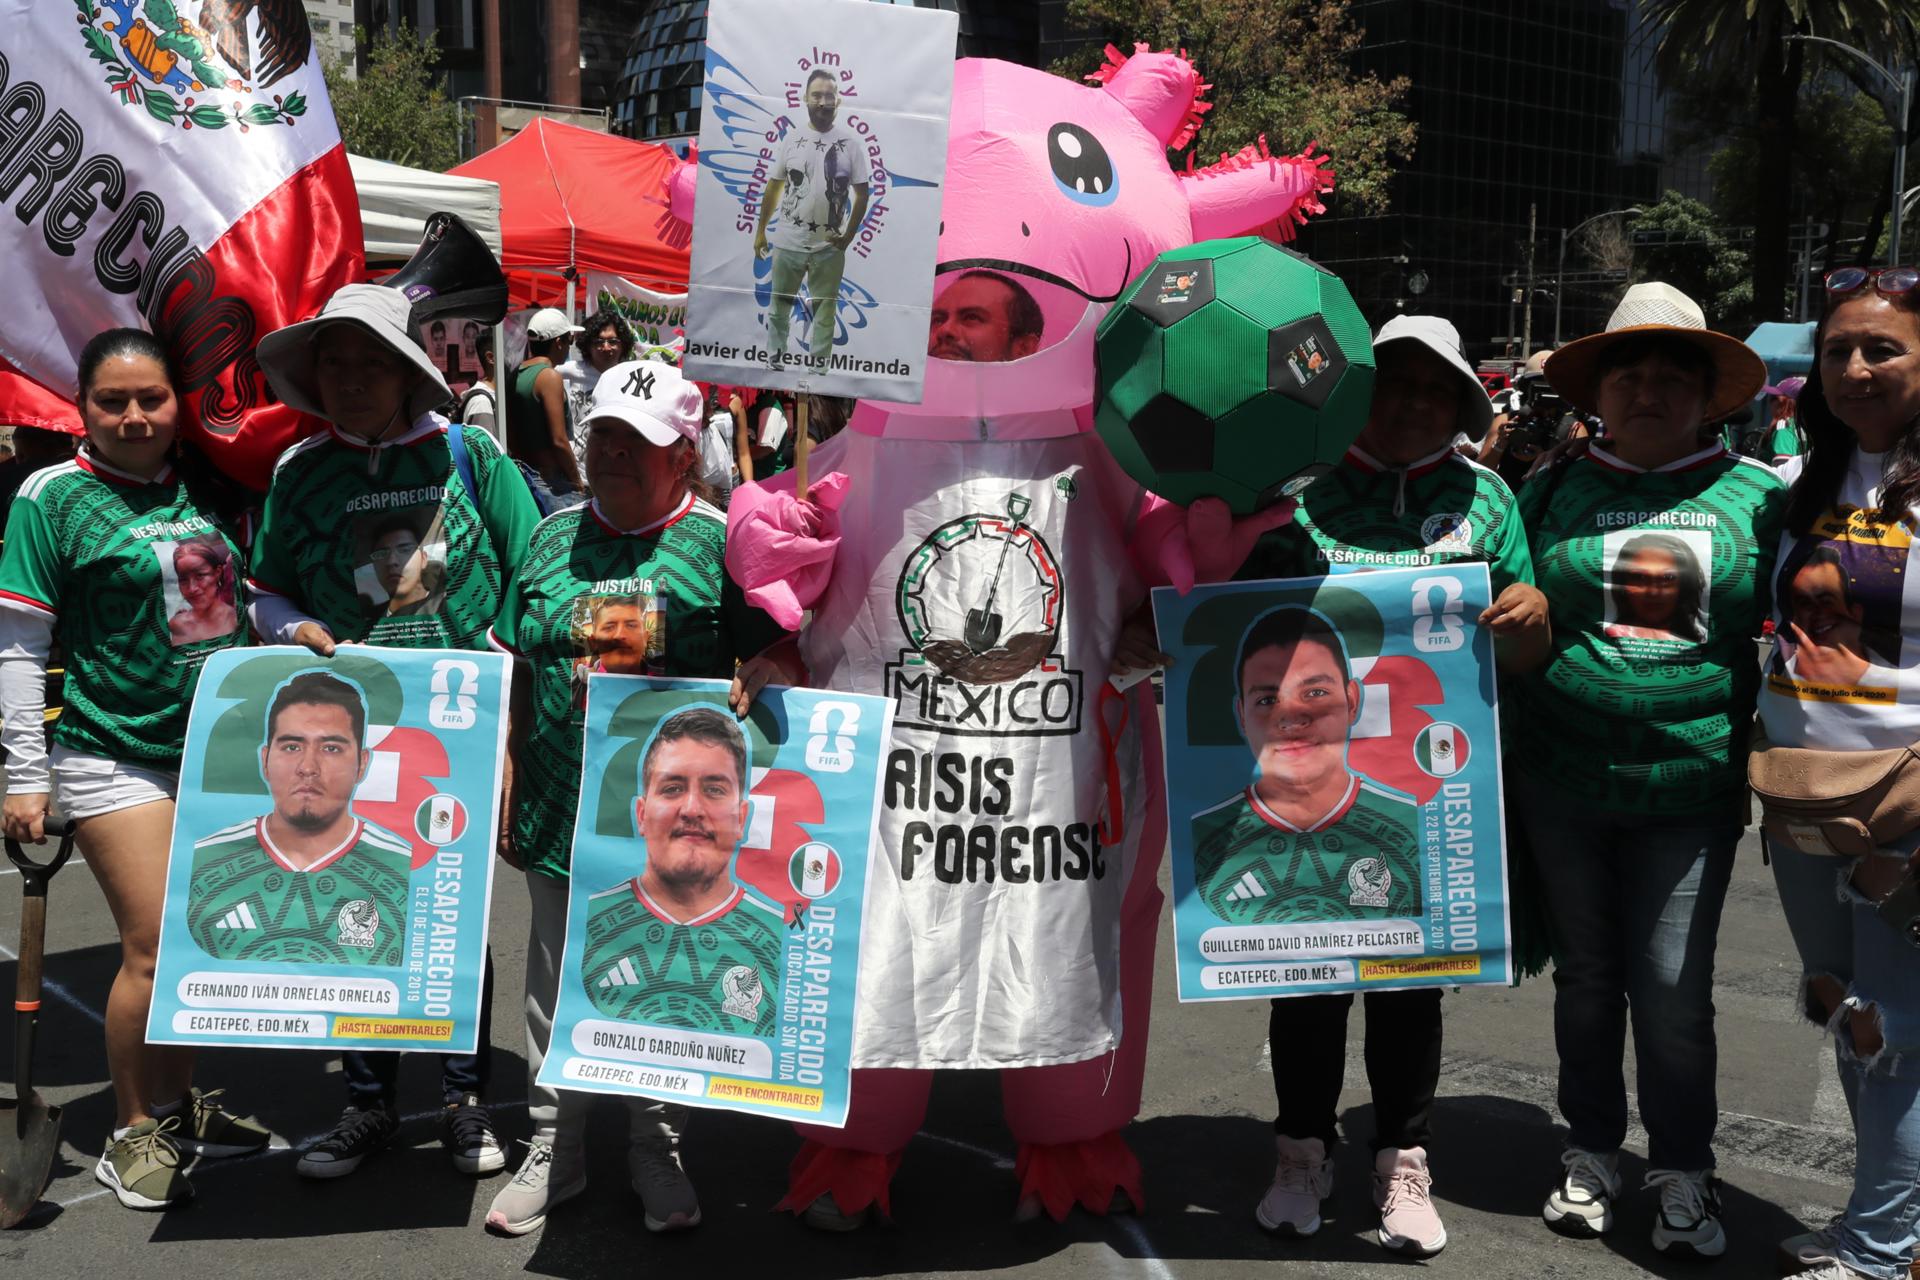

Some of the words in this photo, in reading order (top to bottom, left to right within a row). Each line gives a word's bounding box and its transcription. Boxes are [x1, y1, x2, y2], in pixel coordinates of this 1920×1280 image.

[797, 47, 854, 82] alma
[785, 81, 802, 109] mi
[839, 85, 858, 97] y
[765, 115, 789, 143] en
[846, 114, 887, 196] corazon
[736, 147, 773, 234] Siempre
[0, 50, 272, 437] ARECIDOS
[683, 339, 739, 360] Javier
[744, 345, 769, 362] de
[771, 348, 827, 368] Jesus
[829, 353, 911, 376] Miranda
[346, 486, 448, 513] DESAPARECIDO
[1596, 511, 1717, 528] DESAPARECIDA
[1316, 548, 1431, 565] DESAPARECIDO
[591, 578, 653, 594] JUSTICIA
[1428, 636, 1451, 646] FIFA
[442, 714, 463, 723] FIFA
[818, 756, 840, 766] FIFA
[884, 748, 1015, 816] RISIS
[1425, 801, 1439, 813] EL
[1425, 815, 1439, 828] 22
[1426, 831, 1440, 843] DE
[1427, 845, 1443, 904] SEPTIEMBRE
[1442, 782, 1478, 952] DESAPARECIDO
[415, 887, 429, 898] EL
[415, 901, 428, 913] 21
[1430, 906, 1444, 924] DEL
[414, 917, 427, 929] DE
[411, 932, 425, 958] JULIO
[423, 852, 463, 1017] DESAPARECIDO
[789, 933, 805, 942] Y
[1203, 938, 1265, 953] GUILLERMO
[1268, 936, 1301, 951] DAVID
[1304, 932, 1353, 949] RAMÍREZ
[1357, 931, 1420, 947] PELCASTRE
[1431, 925, 1445, 950] 2017
[410, 960, 423, 974] DE
[1285, 964, 1337, 982] EDO.MÉX
[1362, 965, 1396, 979] ¡HASTA
[1398, 960, 1477, 974] ENCONTRARLES!
[186, 983, 248, 999] FERNANDO
[251, 983, 279, 999] IVÁN
[282, 986, 335, 1002] ORNELAS
[338, 988, 391, 1004] ORNELAS
[407, 976, 422, 1002] 2019
[783, 944, 804, 1022] LOCALIZADO
[796, 905, 836, 1085] DESAPARECIDO
[257, 1017, 310, 1034] EDO.MÉX
[337, 1021, 372, 1035] ¡HASTA
[374, 1021, 450, 1037] ENCONTRARLES!
[781, 1026, 798, 1048] SIN
[593, 1031, 645, 1051] GONZALO
[649, 1038, 703, 1060] GARDUÑO
[707, 1044, 746, 1065] NUÑEZ
[779, 1051, 796, 1081] VIDA
[639, 1071, 689, 1091] EDO.MÉX
[709, 1082, 743, 1097] ¡HASTA
[745, 1086, 820, 1107] ENCONTRARLES!
